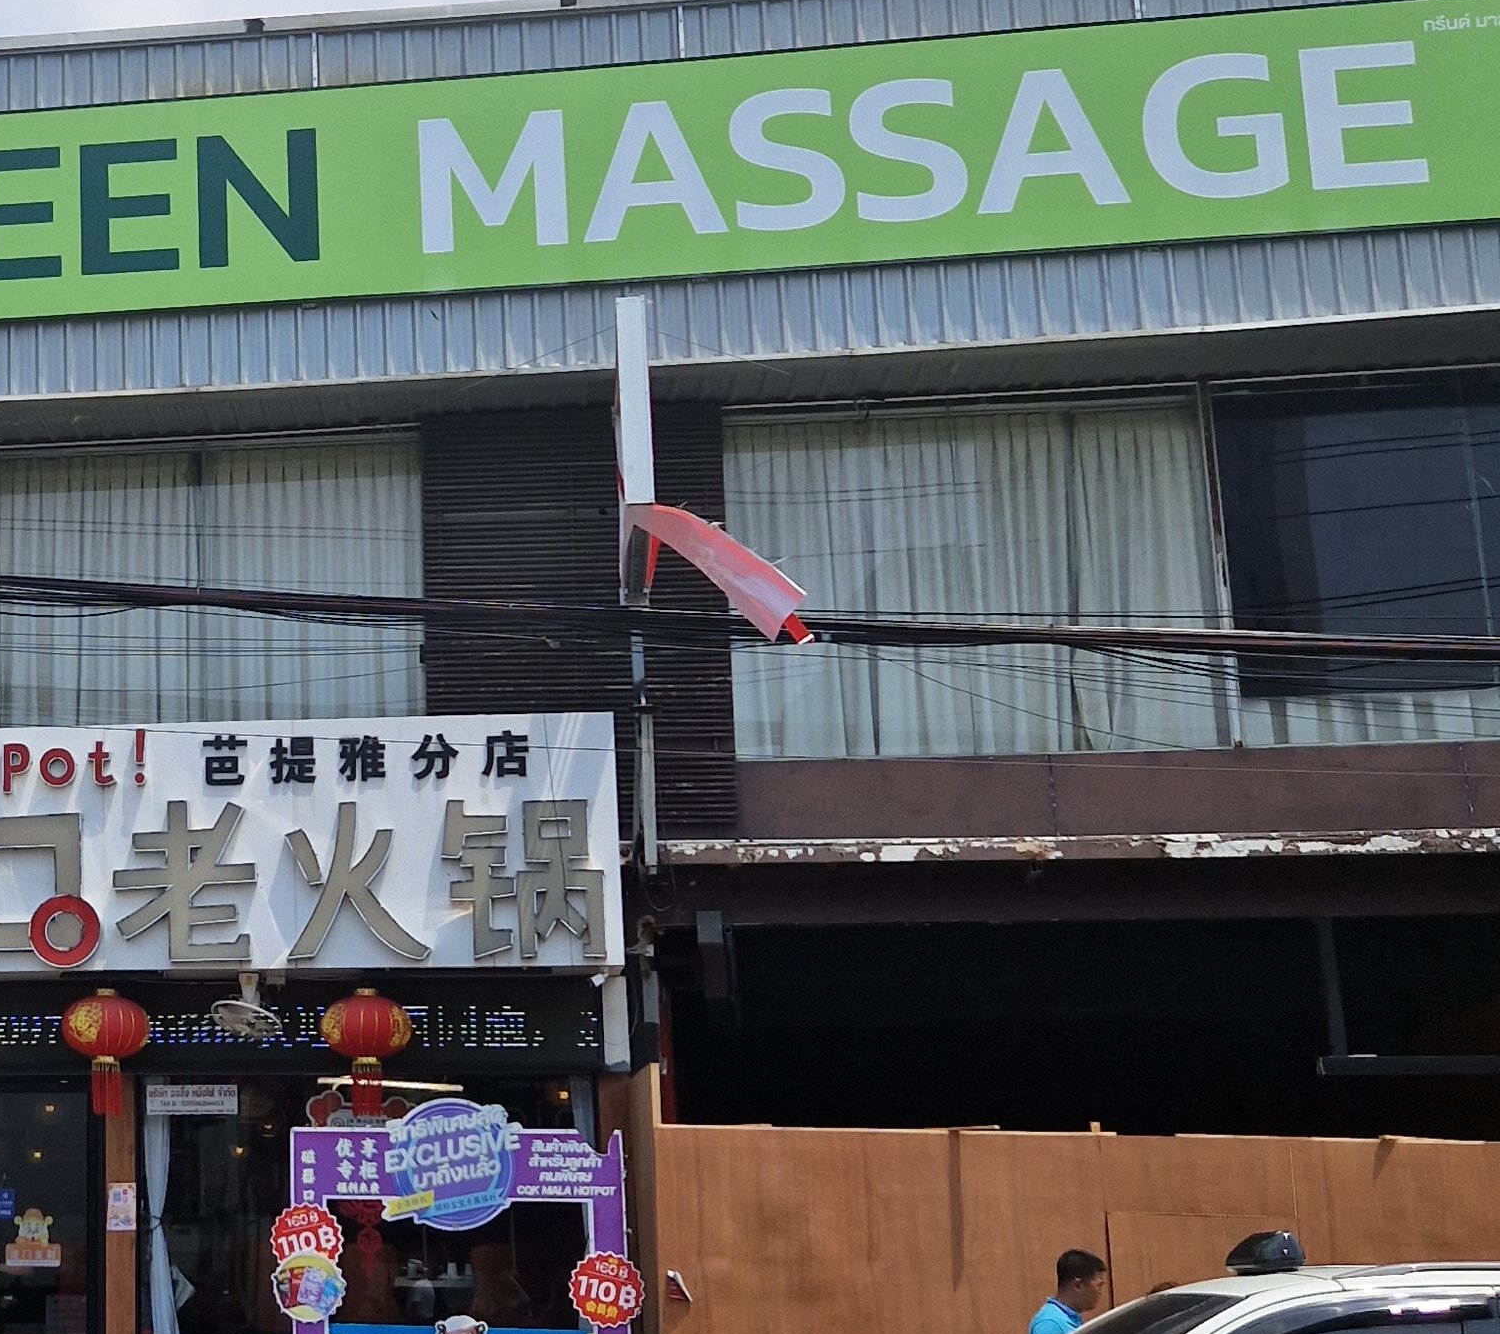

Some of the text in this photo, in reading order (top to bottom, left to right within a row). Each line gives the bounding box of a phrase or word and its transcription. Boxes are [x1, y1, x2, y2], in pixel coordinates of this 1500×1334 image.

[418, 39, 1430, 255] MASSAGE
[202, 730, 531, 787] 芭提雅分店
[384, 1121, 522, 1174] EXCLUSIVE
[516, 1185, 618, 1197] CQK MALA HOTPOT
